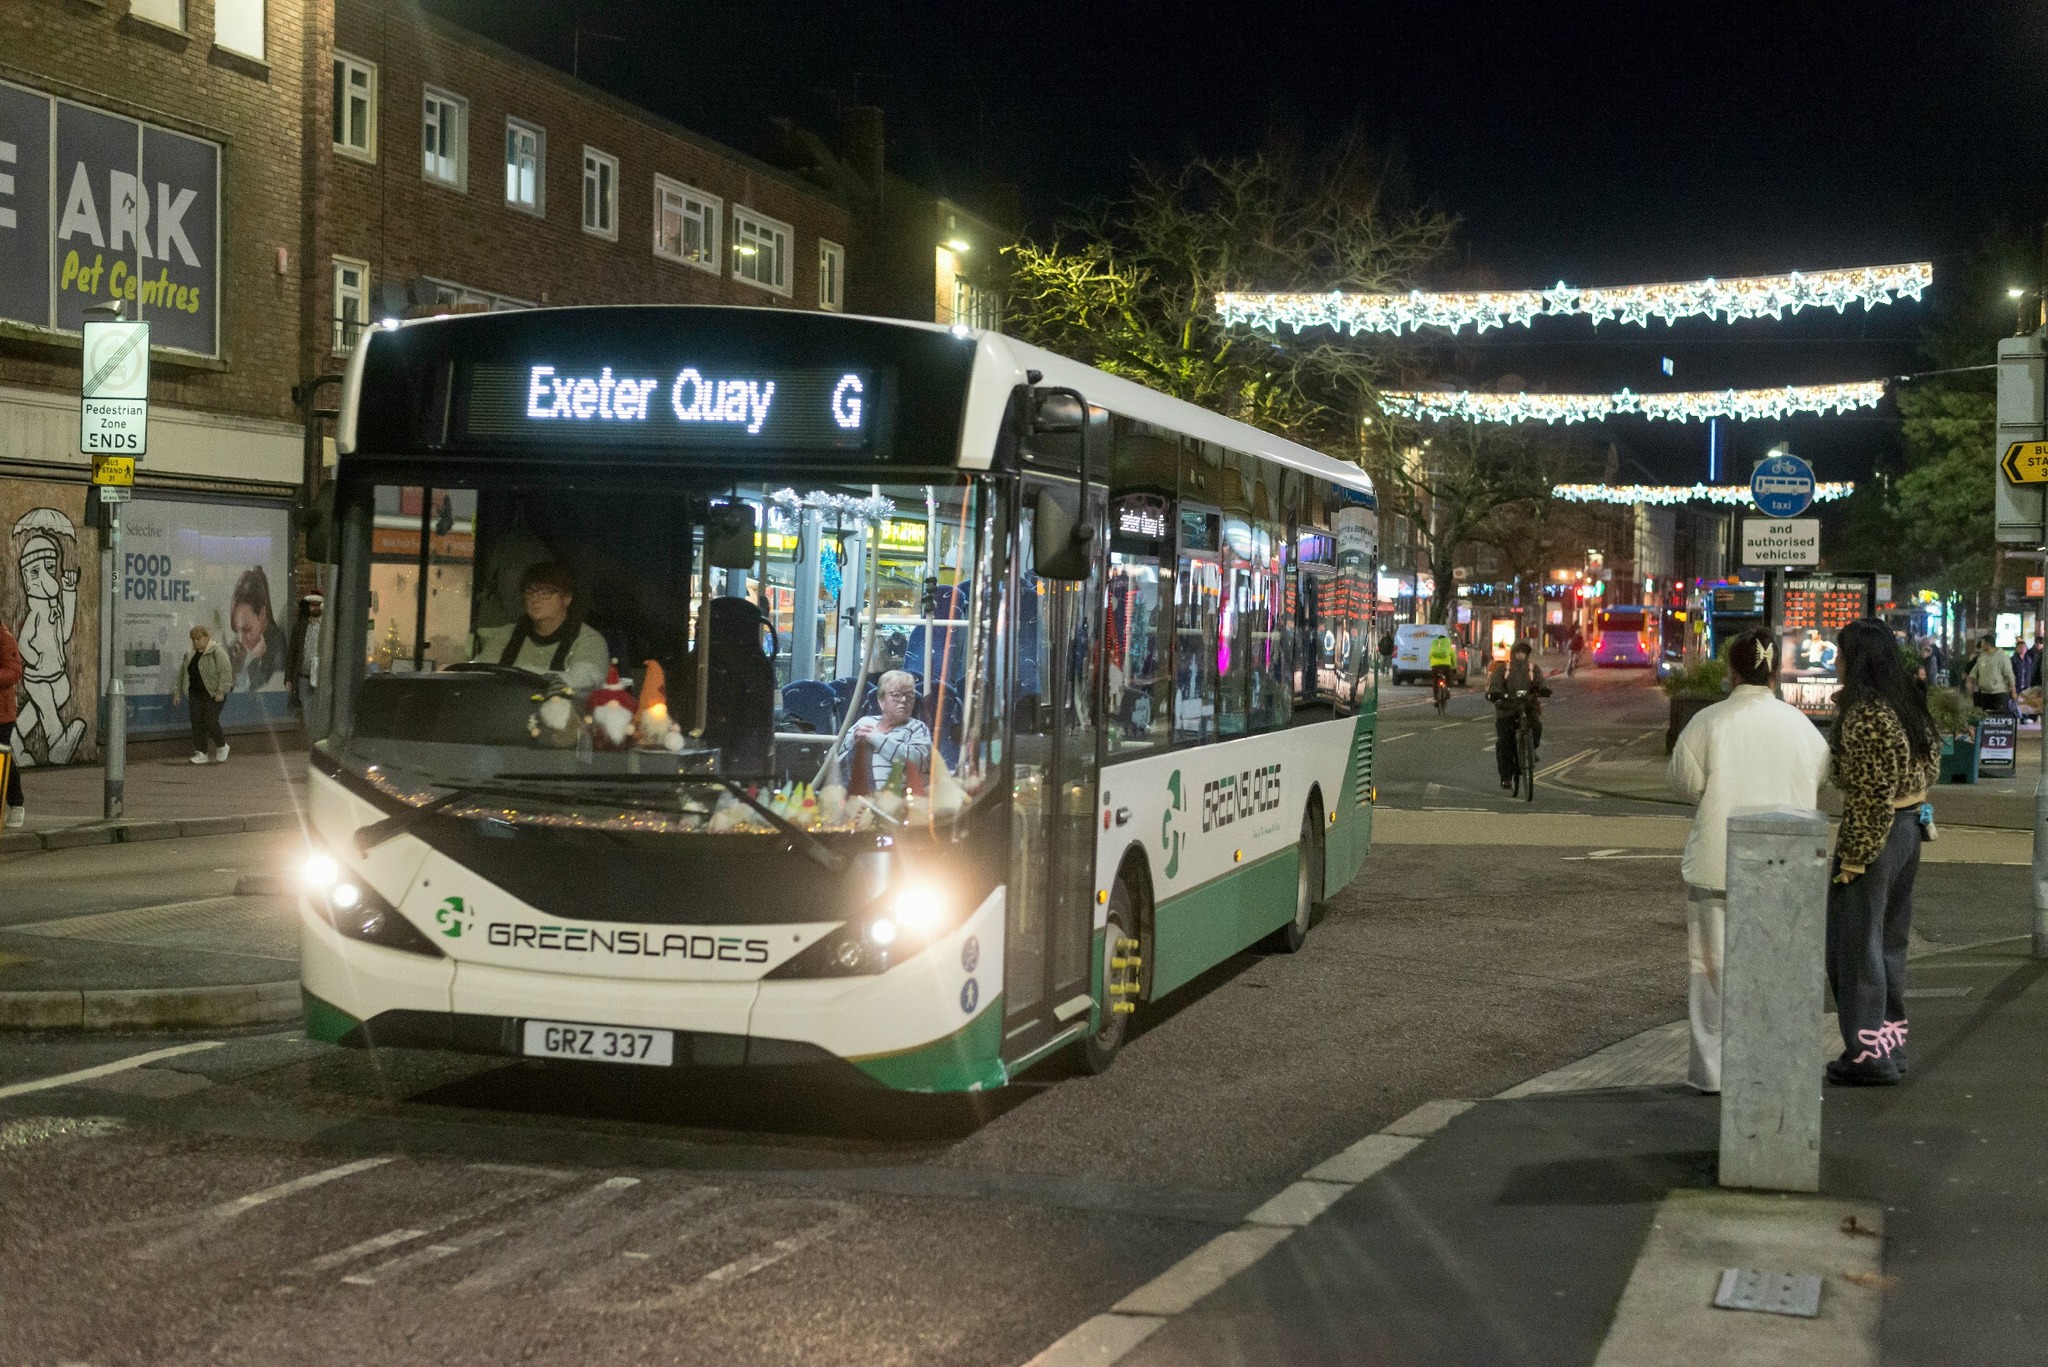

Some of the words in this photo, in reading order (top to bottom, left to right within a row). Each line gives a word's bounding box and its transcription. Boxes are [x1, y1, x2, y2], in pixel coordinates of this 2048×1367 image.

[58, 161, 201, 268] ARK
[61, 250, 104, 295] Pet
[109, 260, 200, 314] Centres
[527, 366, 657, 419] Exeter
[672, 368, 775, 433] Quay
[832, 374, 864, 428] G
[86, 404, 143, 415] Pedestrian
[101, 418, 127, 429] Zone
[90, 433, 137, 449] ENDS
[2035, 445, 2048, 455] BU
[2028, 456, 2048, 467] STA
[1772, 501, 1792, 510] taxi
[1769, 524, 1793, 534] and
[1747, 536, 1815, 547] authorised
[1755, 549, 1807, 560] vehicles
[125, 553, 172, 577] FOOD
[124, 577, 158, 601] FOR
[161, 579, 195, 602] LIFE.
[1789, 581, 1808, 590] BEST
[1809, 581, 1827, 590] FILM
[1202, 763, 1281, 834] GREENSLADES
[488, 923, 769, 964] GREENSLADES
[544, 1027, 594, 1055] GRZ
[602, 1033, 654, 1060] 337
